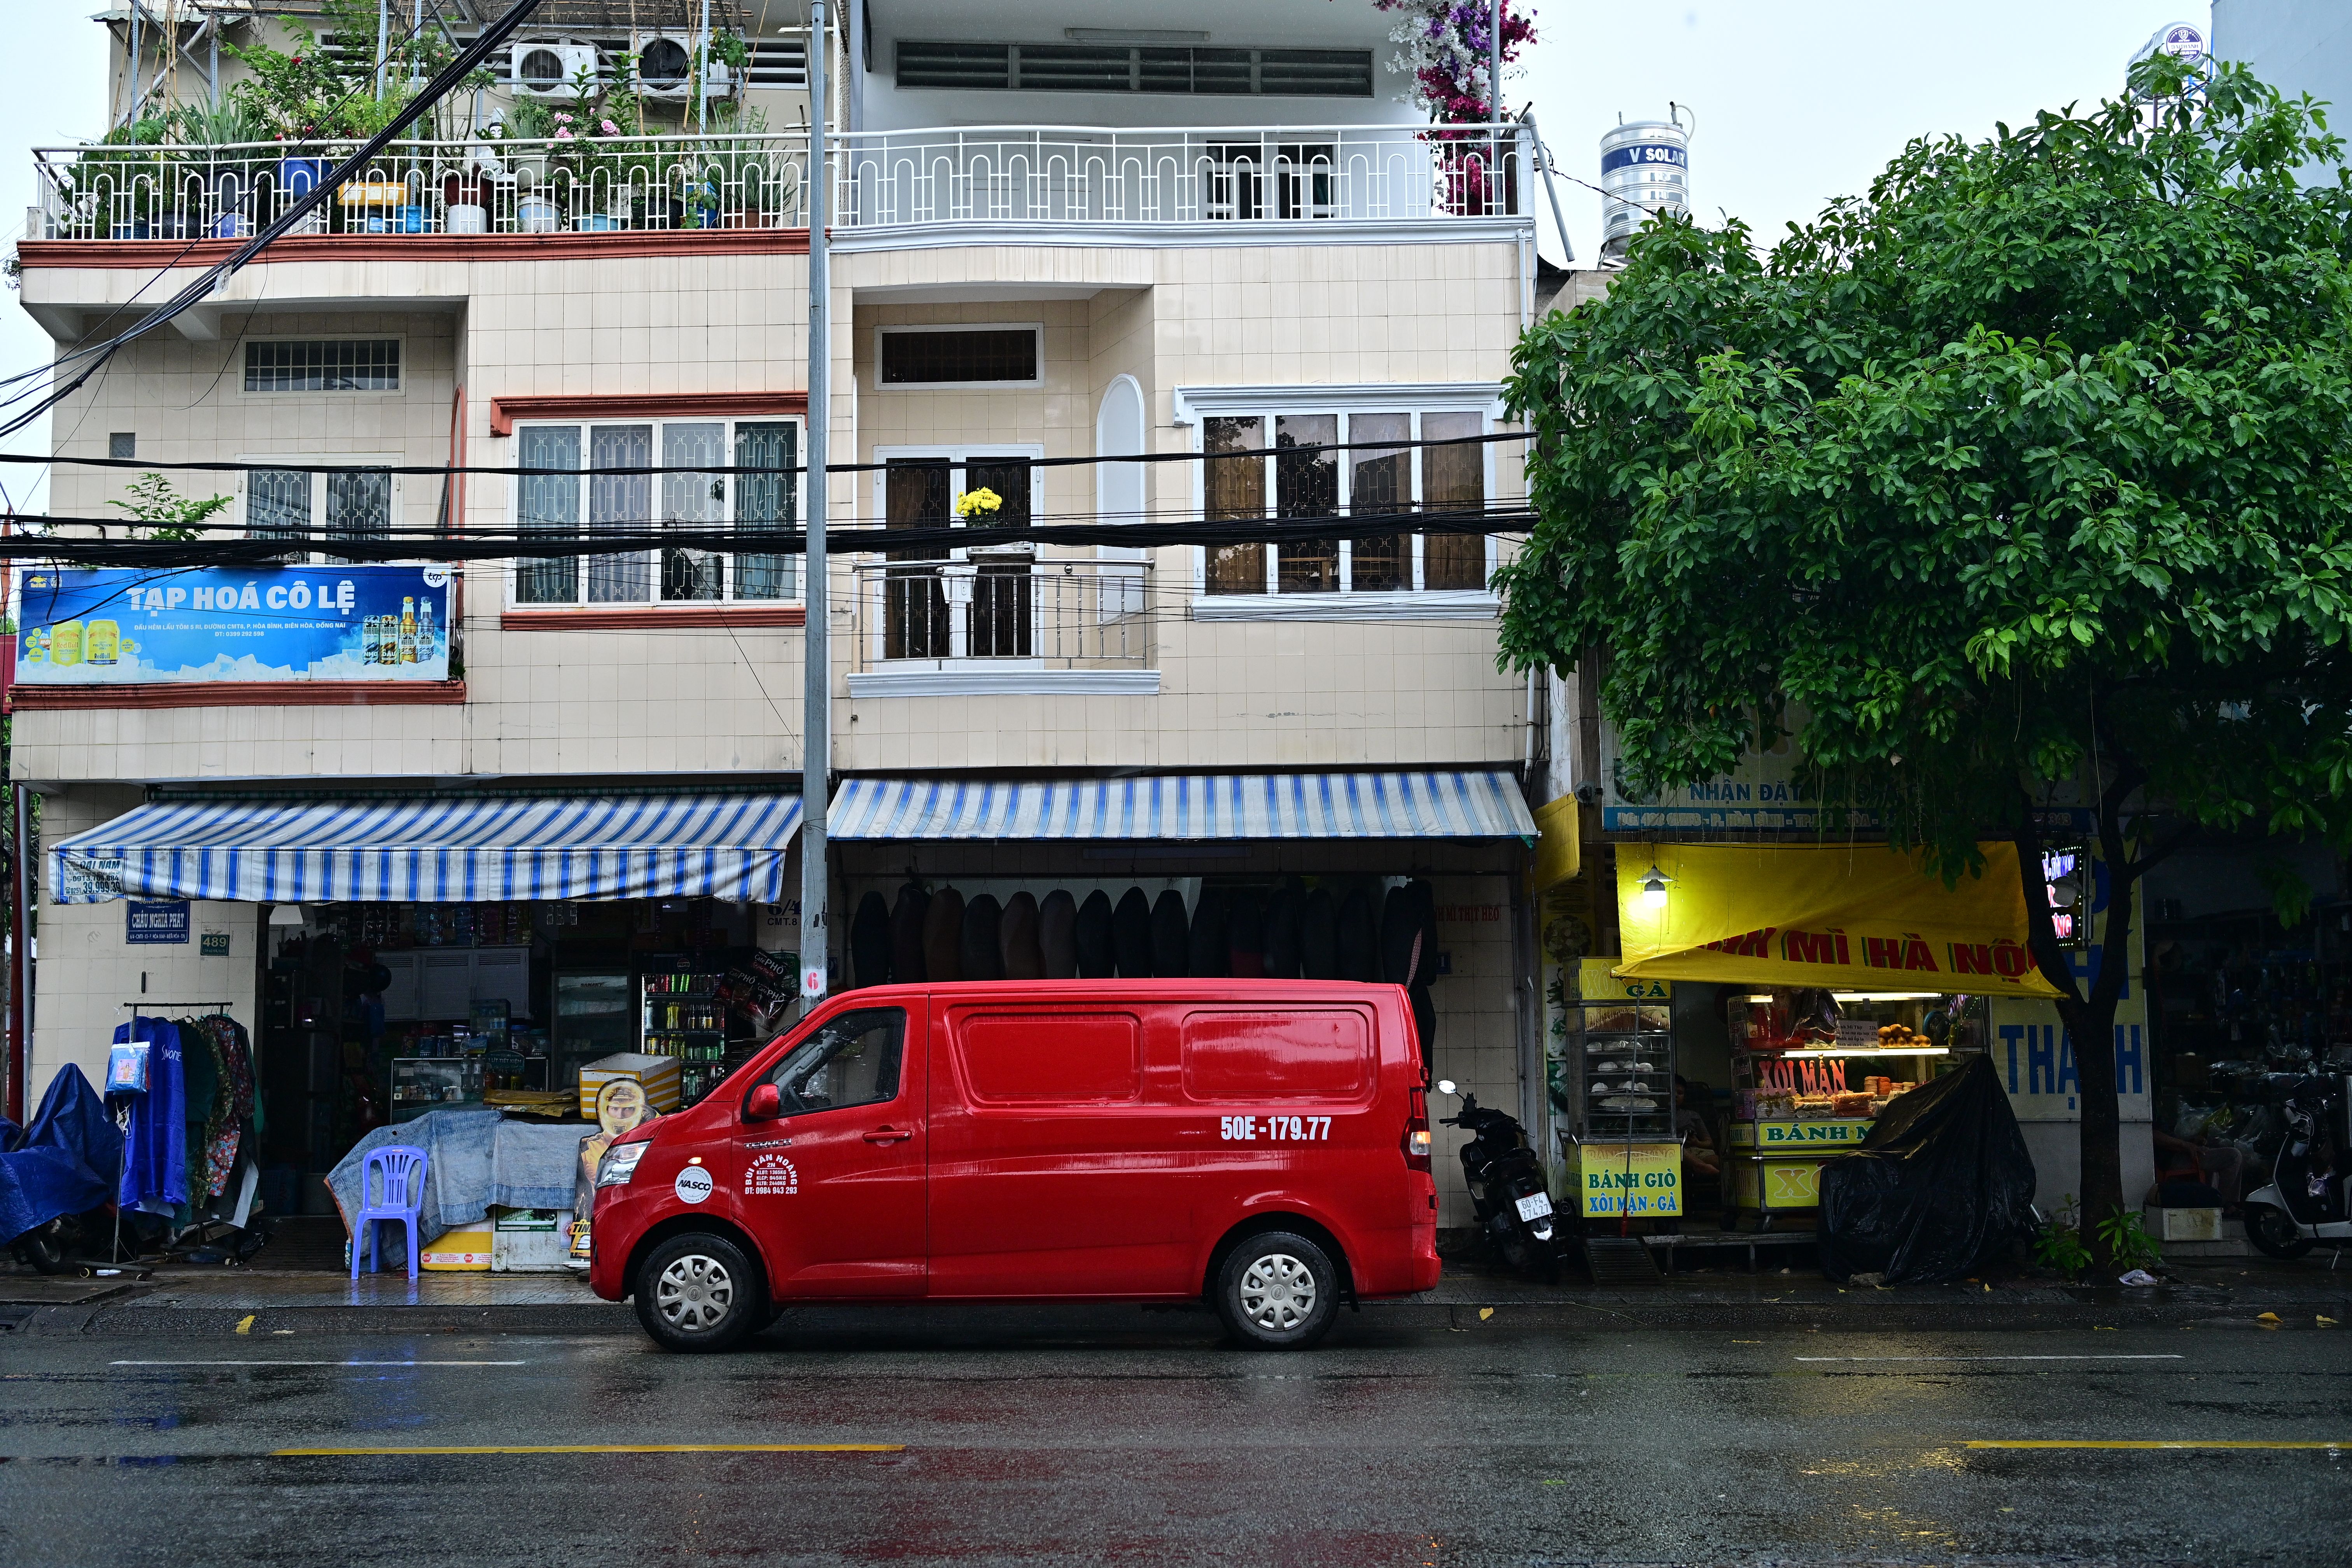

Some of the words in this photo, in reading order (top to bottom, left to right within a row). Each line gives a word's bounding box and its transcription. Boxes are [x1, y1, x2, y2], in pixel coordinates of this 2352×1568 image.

[1629, 147, 1640, 163] V
[1645, 148, 1685, 166] SOLAR
[126, 587, 186, 617] TẠP
[193, 581, 260, 610] HOÁ
[266, 581, 311, 609] CÔ
[318, 580, 355, 615] LỆ
[1760, 780, 1802, 806] ĐẶT
[98, 860, 121, 869] NAM
[767, 899, 802, 915] 6/4
[1481, 906, 1500, 921] HEO
[132, 910, 148, 928] CHÂU
[169, 909, 184, 928] PHÁT
[767, 917, 797, 926] CMT.8
[203, 937, 227, 947] 489
[1781, 927, 1851, 964] MÌ
[1861, 933, 1940, 972] HÀ
[807, 972, 819, 990] 6
[1626, 981, 1667, 998] GÀ
[1999, 1025, 2142, 1110] THẠH
[1766, 1123, 1848, 1141] BÁNH
[677, 1180, 711, 1191] NASCO
[1589, 1169, 1640, 1188] BÁNH
[1645, 1168, 1676, 1188] GIÒ
[1521, 1195, 1543, 1209] 60-F4
[1589, 1192, 1614, 1211] XÔI
[1617, 1192, 1648, 1214] MẶN
[1657, 1191, 1677, 1211] GÀ
[1522, 1204, 1549, 1220] 274.27
[573, 1221, 590, 1233] TỈN
[577, 1235, 590, 1249] S
